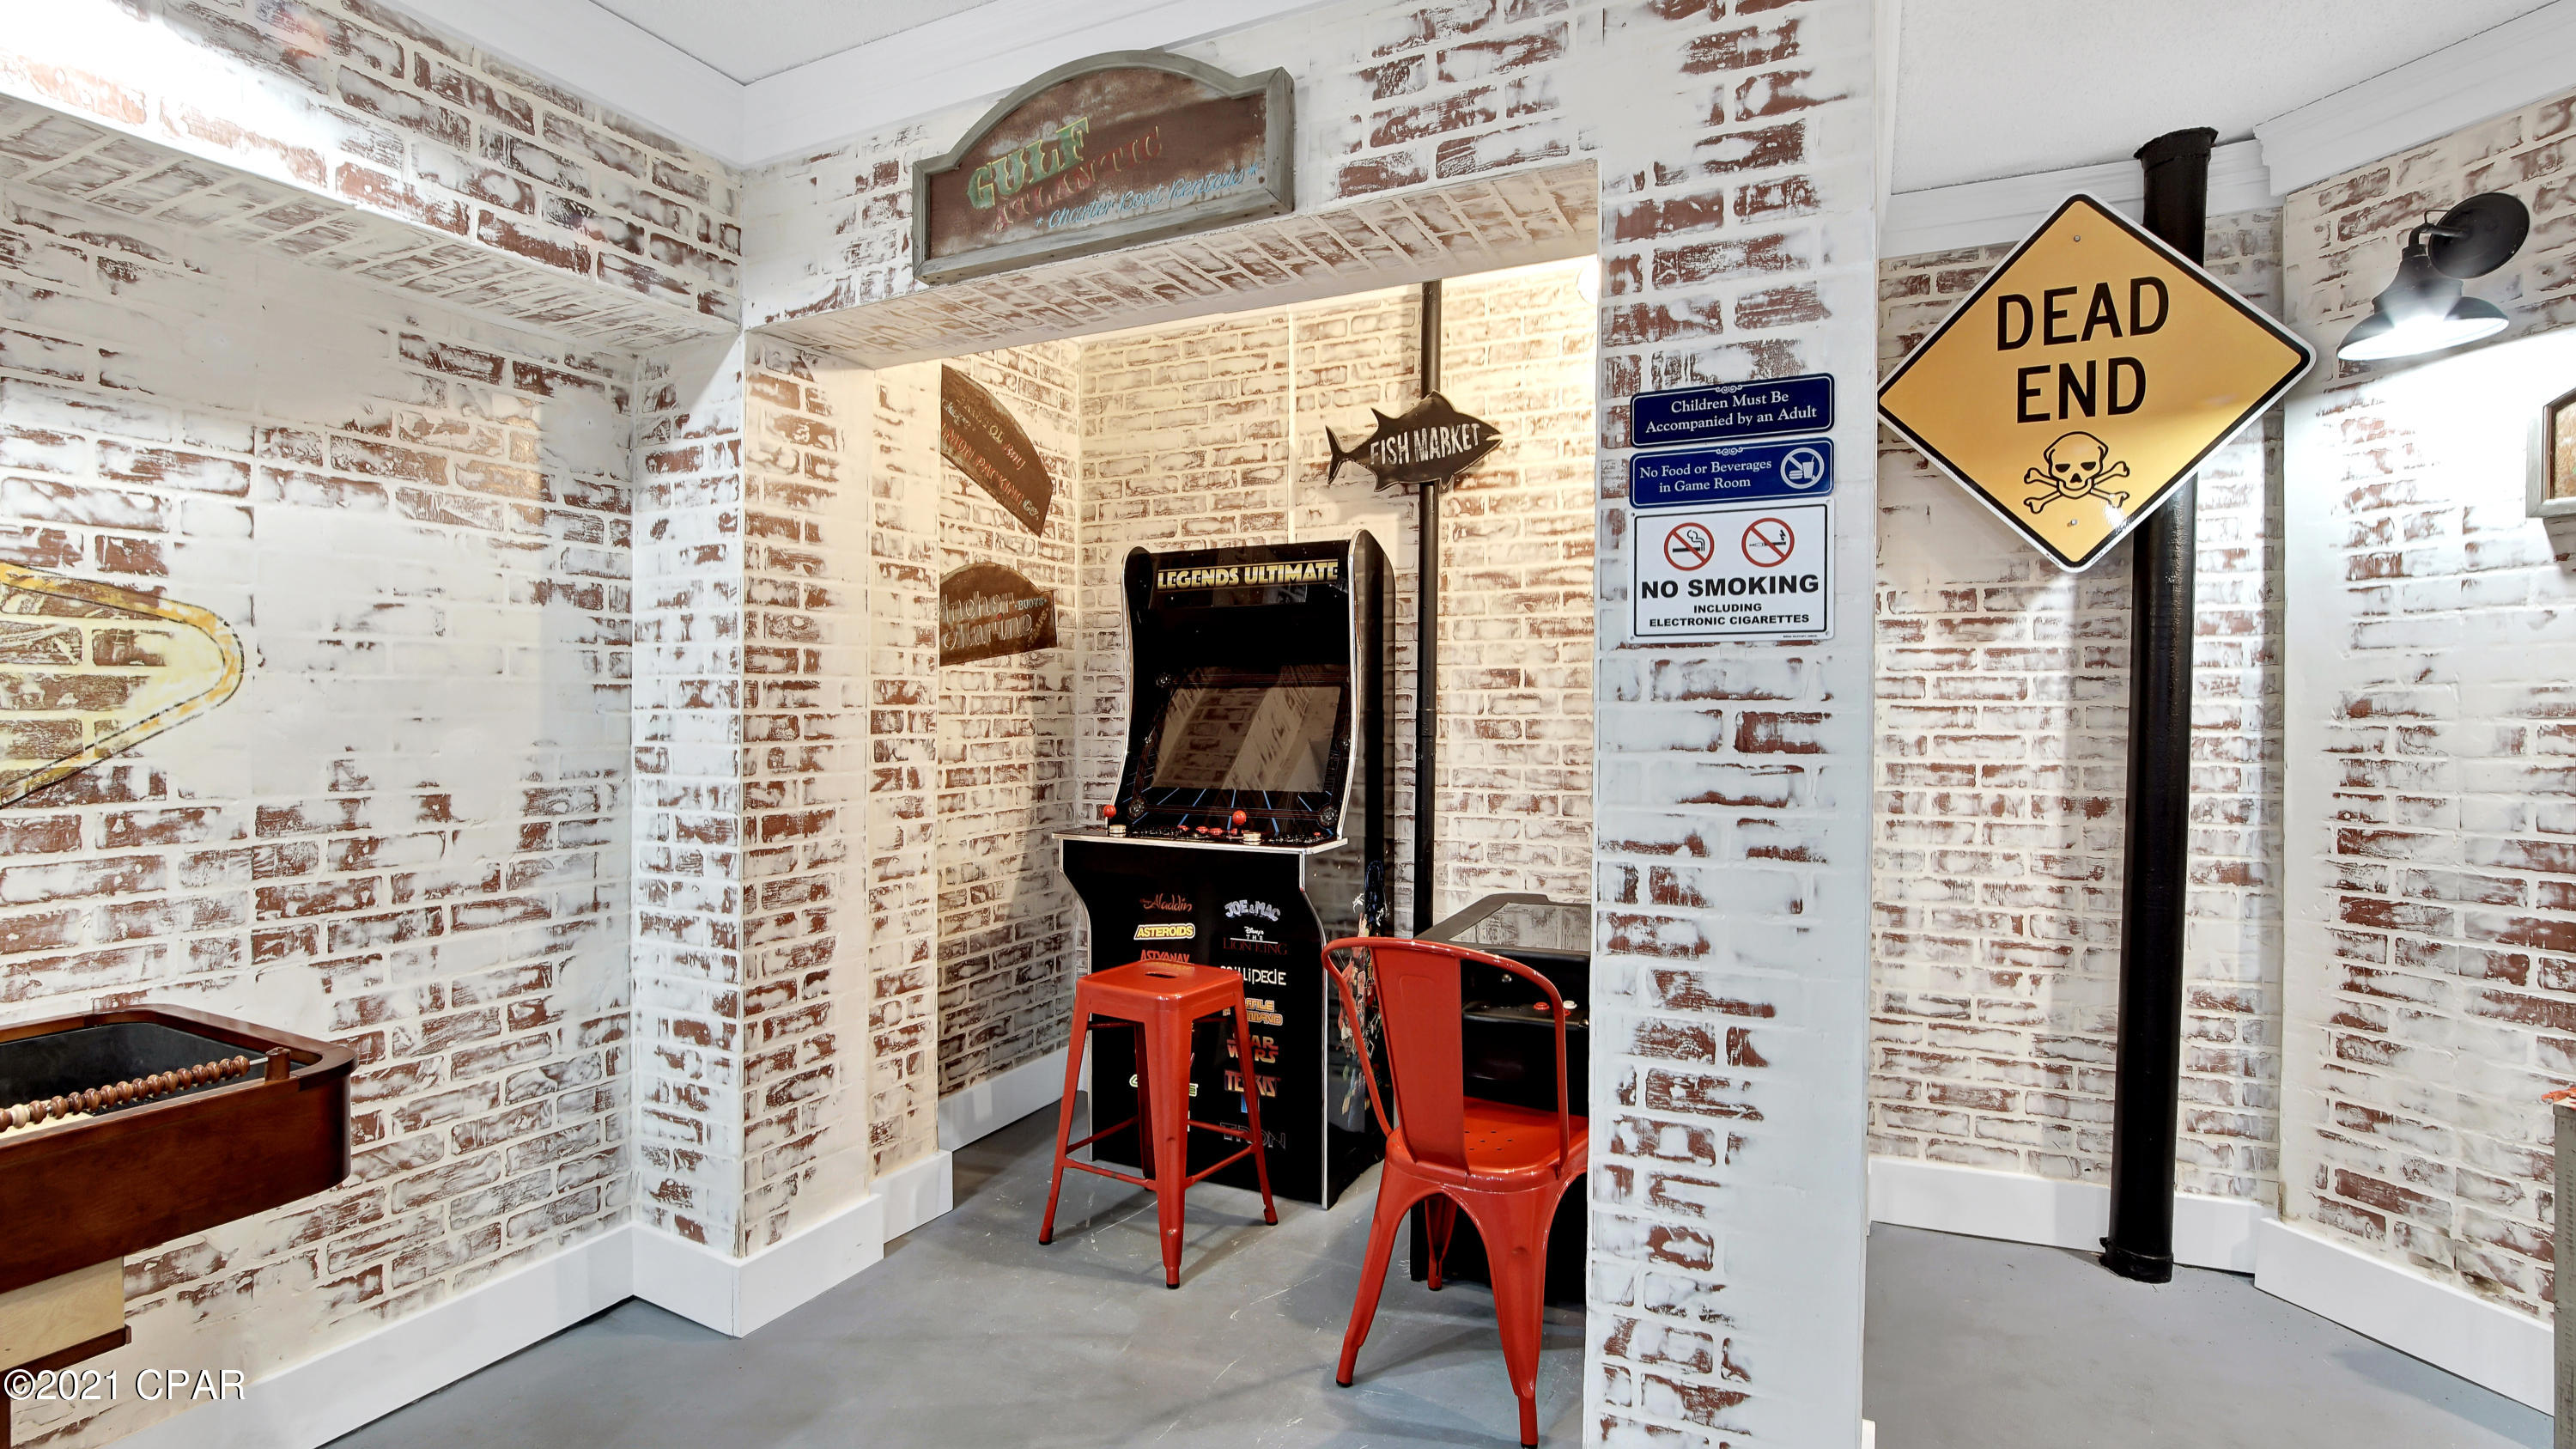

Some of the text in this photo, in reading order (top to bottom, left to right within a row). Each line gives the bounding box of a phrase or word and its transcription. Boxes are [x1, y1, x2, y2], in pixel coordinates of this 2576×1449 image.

[967, 116, 1089, 209] GULF
[991, 126, 1162, 234] ATLANTIC
[1118, 185, 1164, 212] Boat
[1169, 165, 1244, 200] Rentals
[1997, 276, 2169, 351] DEAD
[1671, 391, 1789, 413] Children Must Be
[2017, 356, 2147, 423] END
[1645, 405, 1817, 433] Accompanied by an Adult
[1370, 423, 1479, 466] FISH MARKET
[975, 454, 1024, 508] PACKING
[1640, 460, 1771, 478] No Food or Beverages
[1659, 477, 1751, 492] in Game Room
[1157, 560, 1338, 590] LEGENDS ULTIMATE
[1642, 574, 1819, 599] NO SMOKING
[1649, 614, 1809, 627] ELECTRONIC CIGARETTES
[1693, 604, 1762, 613] INCLUDING
[1143, 893, 1193, 912] Aladdin
[1224, 899, 1249, 918] JOE
[1255, 900, 1281, 922] MAC
[1135, 924, 1194, 939] ASTEROIDS
[1223, 937, 1288, 955] LION KING
